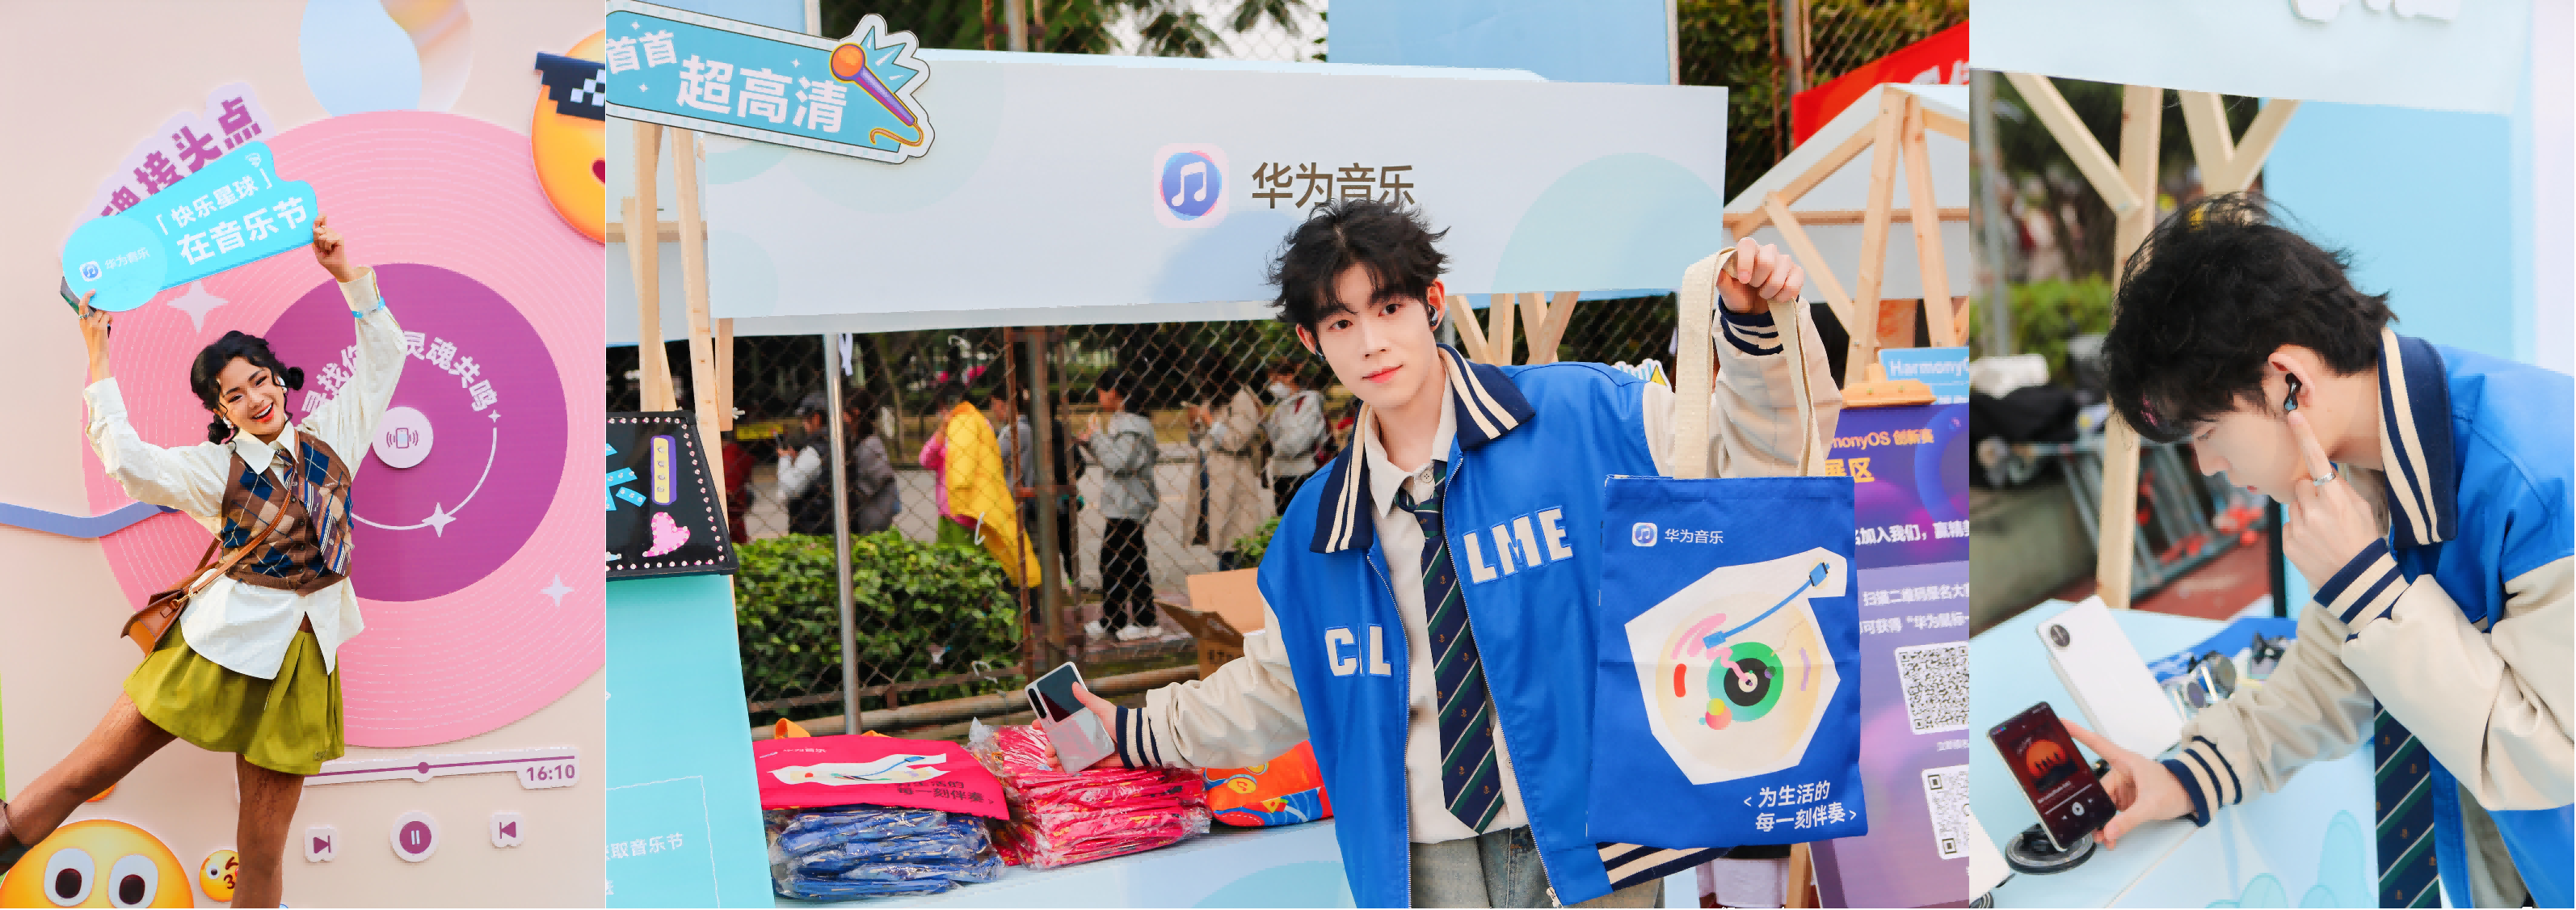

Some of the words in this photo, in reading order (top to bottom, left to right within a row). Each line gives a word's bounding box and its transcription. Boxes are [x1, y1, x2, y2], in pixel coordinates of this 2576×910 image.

[606, 30, 677, 74] 首首
[676, 54, 848, 133] 超高清
[1252, 162, 1415, 209] 华为音乐
[176, 196, 308, 265] 在音乐节
[104, 246, 151, 270] 华为音乐
[1463, 505, 1574, 584] LME
[1665, 528, 1724, 545] 华为音乐
[1324, 624, 1392, 677] CL
[526, 764, 575, 782] 16:10
